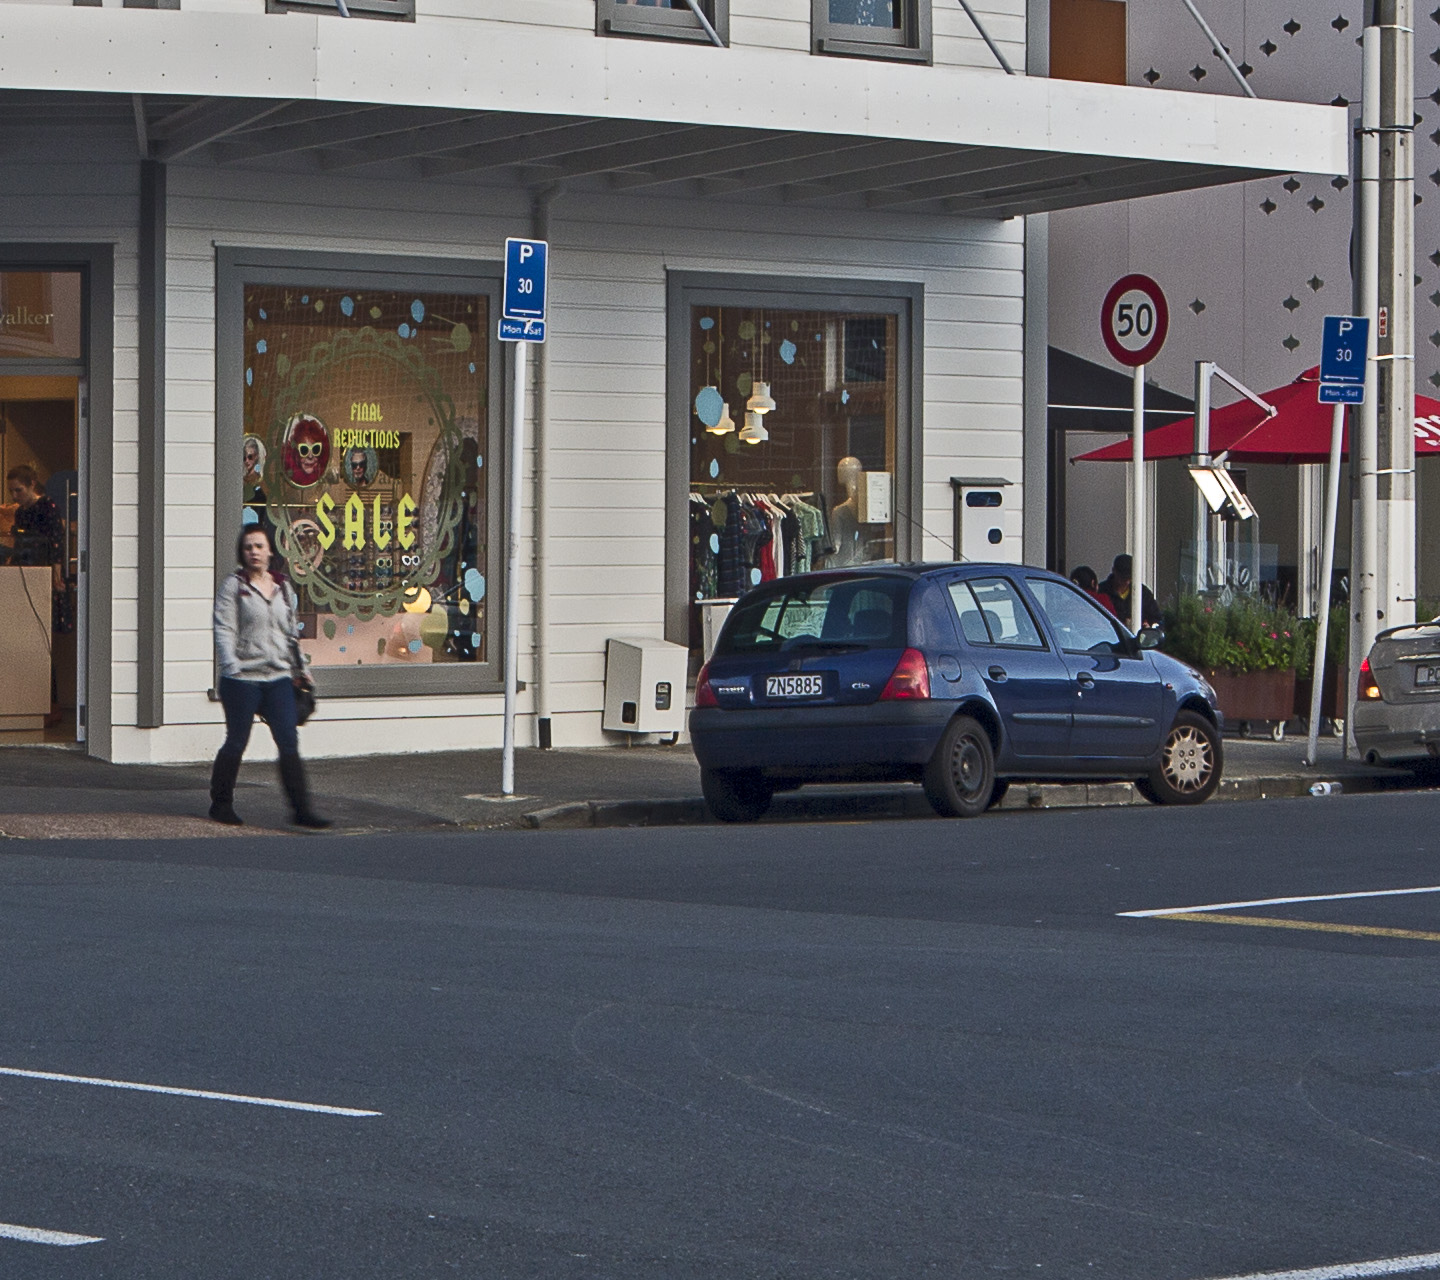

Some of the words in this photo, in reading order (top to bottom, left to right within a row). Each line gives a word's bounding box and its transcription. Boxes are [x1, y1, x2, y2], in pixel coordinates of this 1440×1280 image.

[520, 244, 533, 264] P
[518, 278, 533, 294] 30
[503, 324, 521, 335] Mon
[1117, 303, 1153, 337] 50
[1338, 321, 1353, 337] P
[1335, 348, 1352, 362] 30
[350, 402, 383, 422] FINAL
[333, 428, 400, 449] REDUCTIONS
[316, 492, 416, 551] SALE
[768, 677, 822, 695] ZN5885
